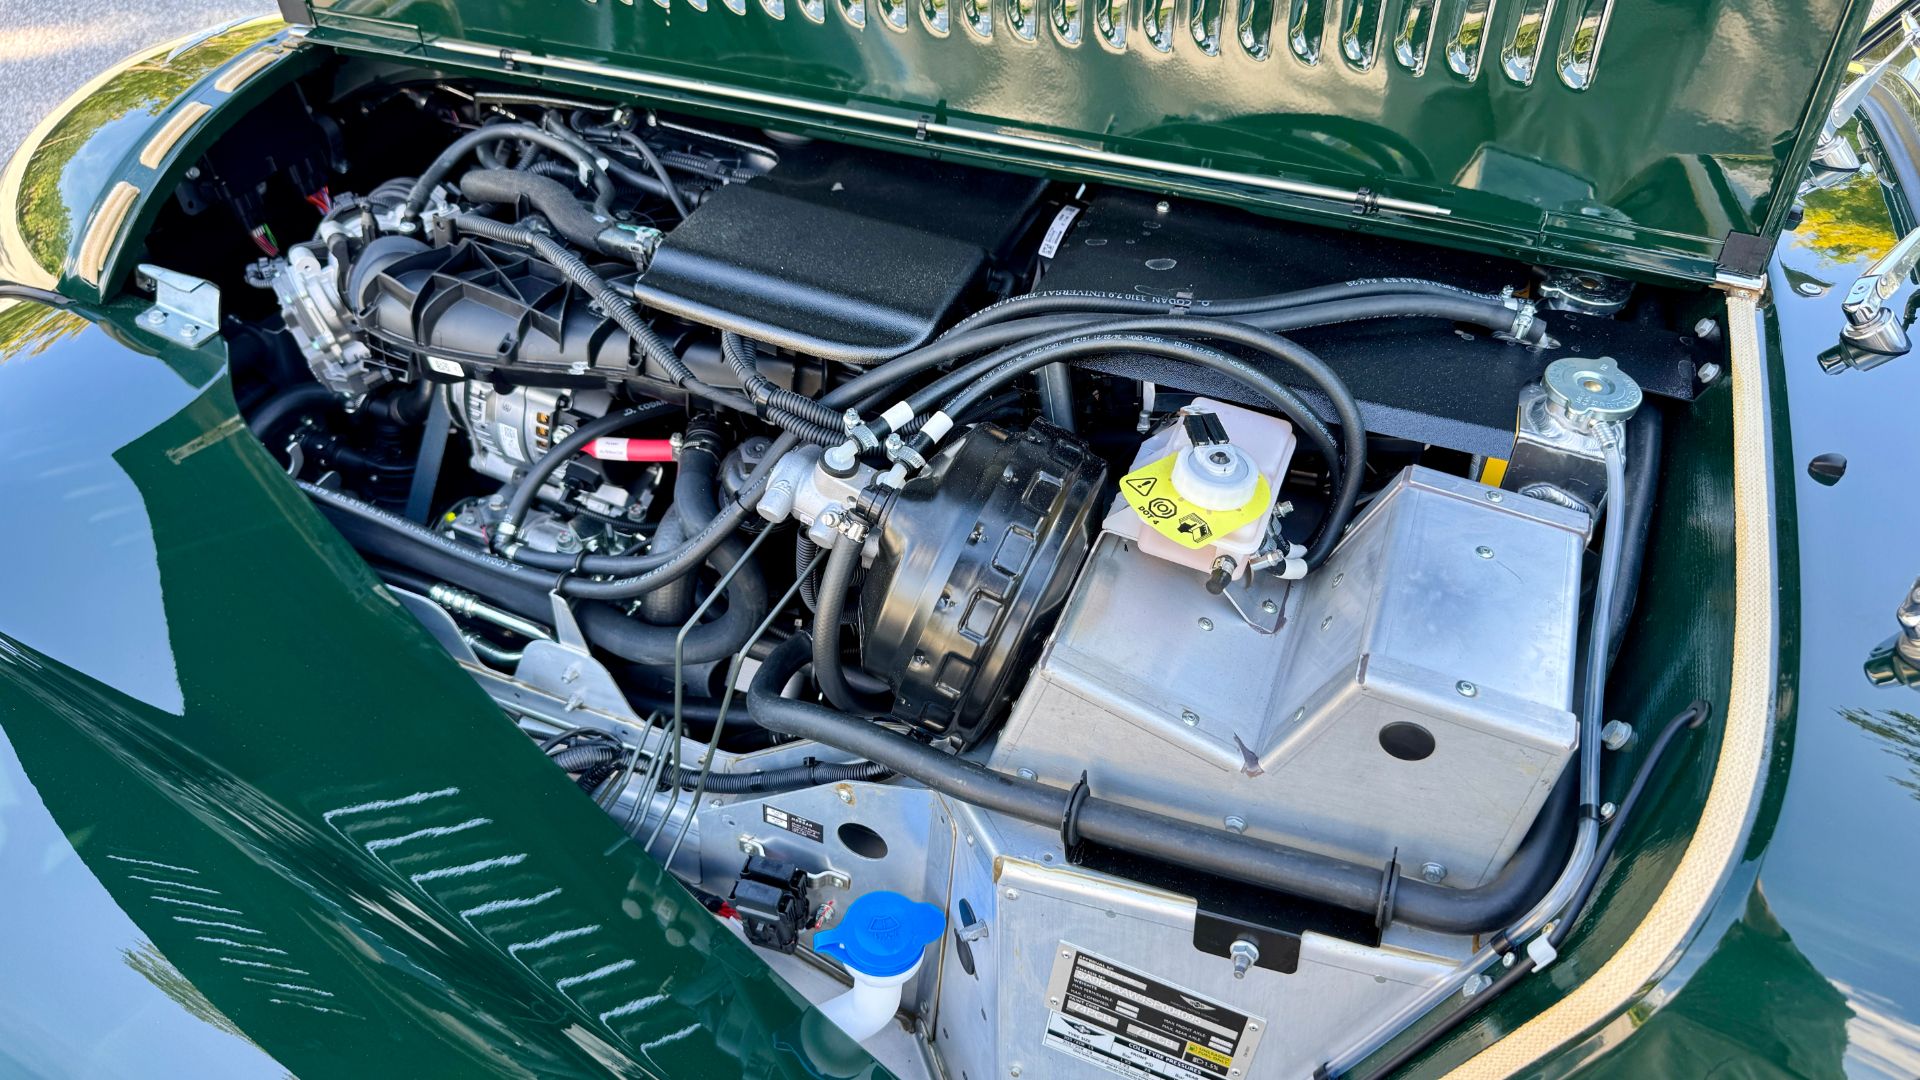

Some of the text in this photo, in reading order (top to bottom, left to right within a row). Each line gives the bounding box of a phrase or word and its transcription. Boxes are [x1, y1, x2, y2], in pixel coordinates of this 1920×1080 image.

[1125, 293, 1146, 302] 3310
[1152, 296, 1192, 306] CODAN
[1137, 505, 1154, 519] DOT
[1128, 1042, 1202, 1075] COLD TYRE PRESSURES
[1199, 1047, 1230, 1062] UNLEADED
[1212, 1055, 1228, 1065] ONLY
[1204, 1060, 1219, 1071] 1.5%
